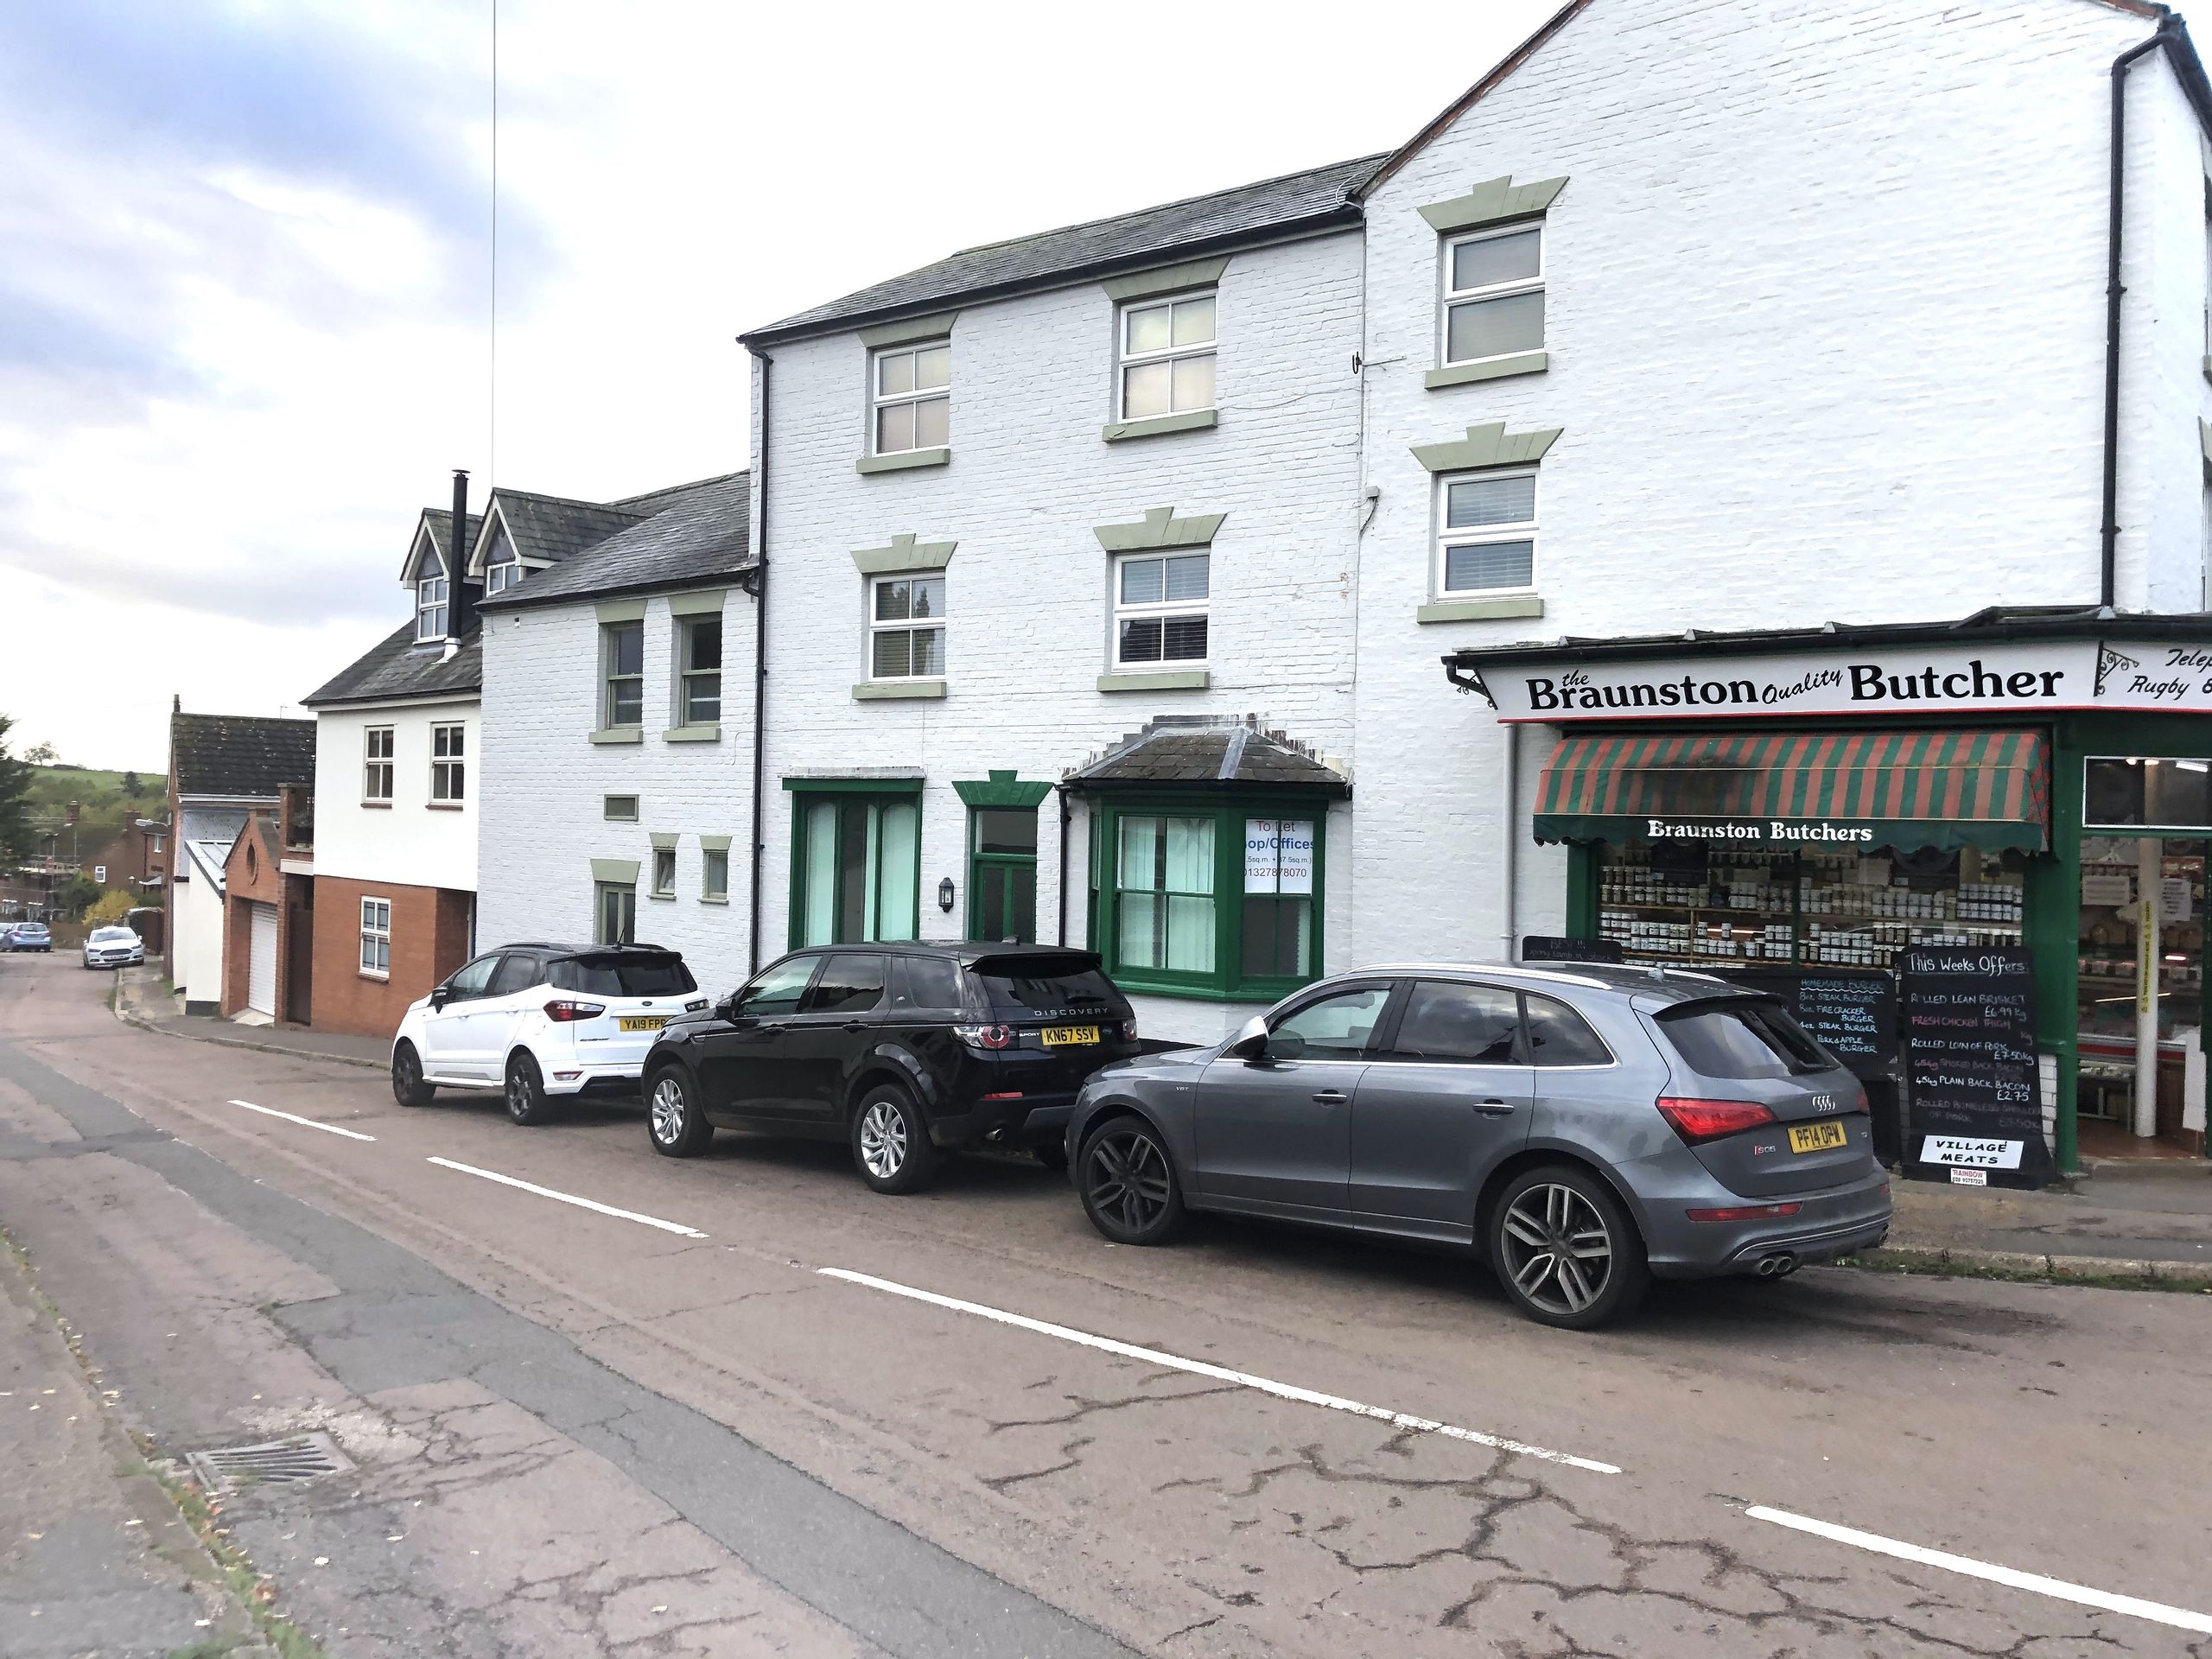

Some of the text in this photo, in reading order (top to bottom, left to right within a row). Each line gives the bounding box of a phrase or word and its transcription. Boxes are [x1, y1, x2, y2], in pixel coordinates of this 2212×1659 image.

[1526, 660, 2064, 709] the Braunston Quality Butcher
[2127, 675, 2190, 701] Rugby
[1255, 820, 1271, 832] To
[1647, 820, 1872, 841] Braunston Butchers
[1905, 952, 2025, 976] This Weeks Offers
[1818, 993, 1842, 1002] STEAK
[1843, 995, 1876, 1004] BURGER
[1952, 994, 1976, 1004] LEAN
[1979, 994, 2025, 1005] BRISKET
[1034, 1007, 1108, 1016] DISCOVERY
[625, 1019, 646, 1030] YA19
[1840, 1014, 1875, 1024] BURGER
[1818, 1022, 1842, 1031] STEAK
[1844, 1023, 1878, 1033] BURGER
[1046, 1027, 1094, 1043] KN67 SSV
[1840, 1044, 1878, 1053] BURGER
[1911, 1037, 2010, 1052] ROLLED LOIN OF PORK
[1916, 1076, 2031, 1092] 454g PLAIN BACK BACON
[1916, 1097, 1950, 1109] ROLLED
[1795, 1126, 1821, 1149] PF14
[1936, 1141, 2007, 1153] VILLAGE
[1940, 1153, 1998, 1165] MEATS
